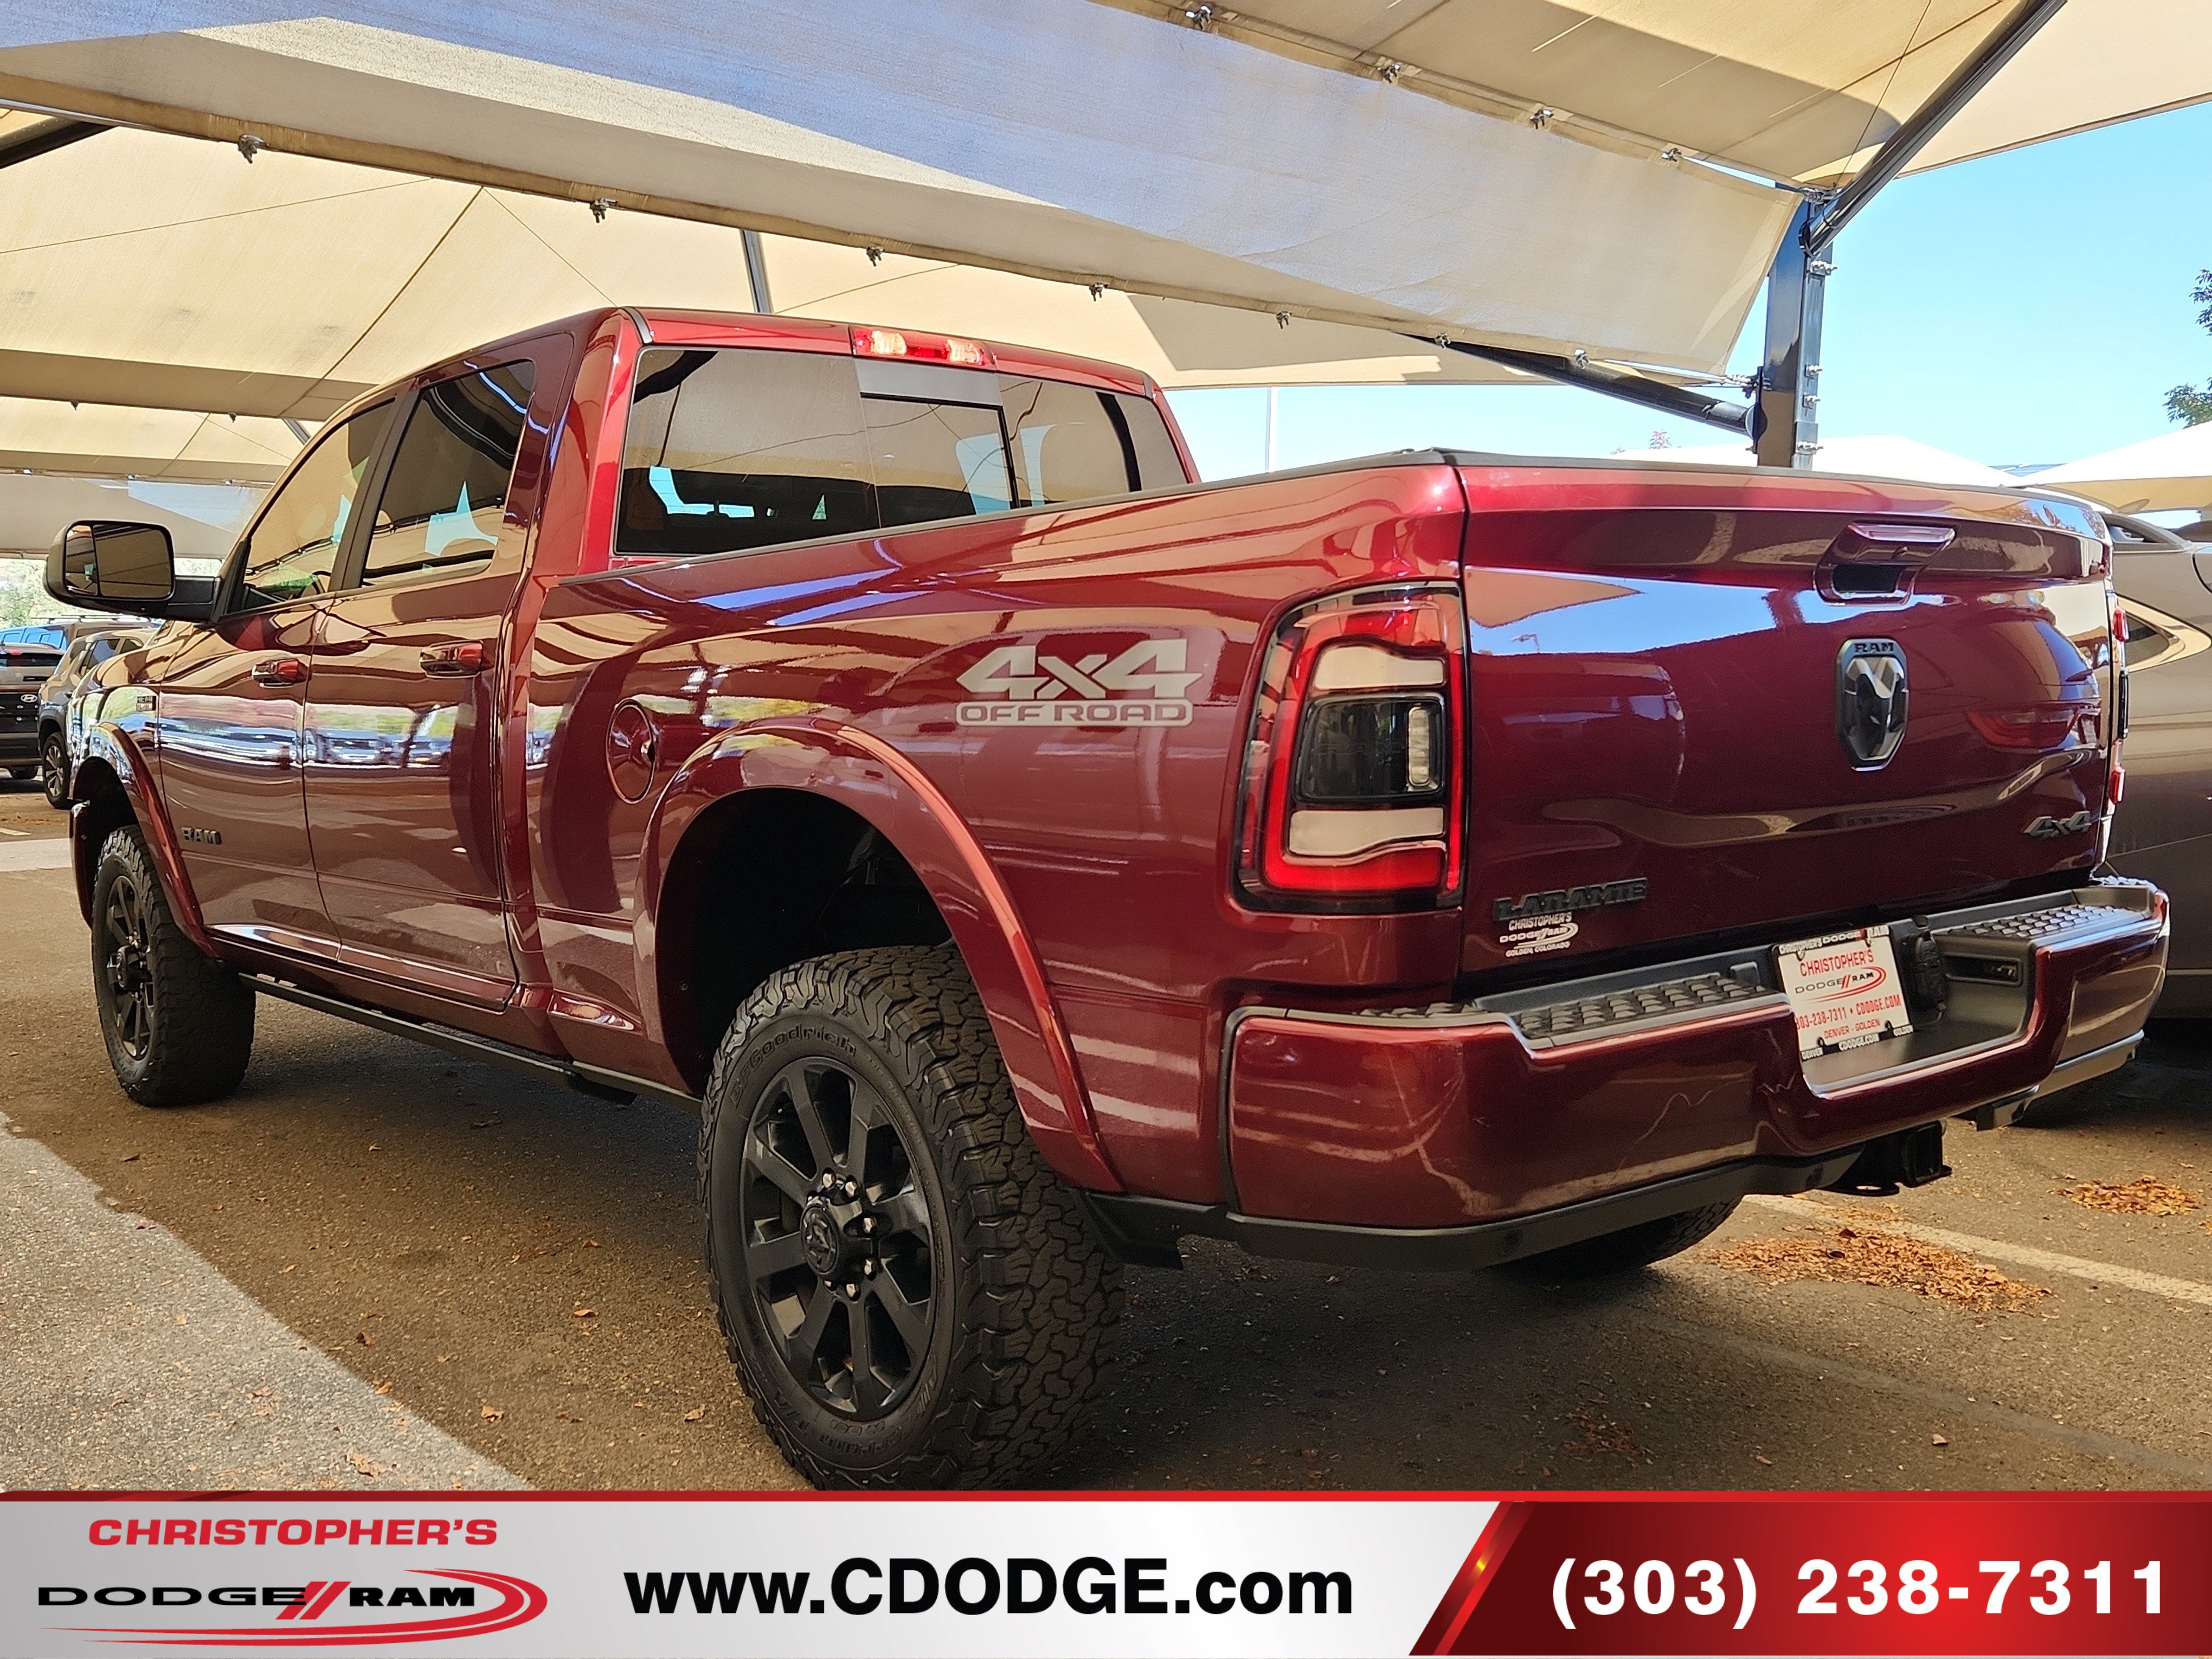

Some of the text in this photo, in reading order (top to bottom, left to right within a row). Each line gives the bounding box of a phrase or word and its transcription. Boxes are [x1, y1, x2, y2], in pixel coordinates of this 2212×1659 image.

[1854, 642, 1894, 653] RAM
[957, 638, 1203, 700] 4x4
[961, 704, 1187, 722] OFF ROAD
[181, 826, 221, 845] RAM
[1508, 911, 1572, 931] CHRISTOPHER'S
[1800, 949, 1874, 976] CHRISTOPHER'S
[1795, 971, 1875, 994] DODGE RAM
[1795, 994, 1902, 1030] 303-238-7311 CDODGE.COM
[1824, 1018, 1880, 1039] DENVER GOLDEN
